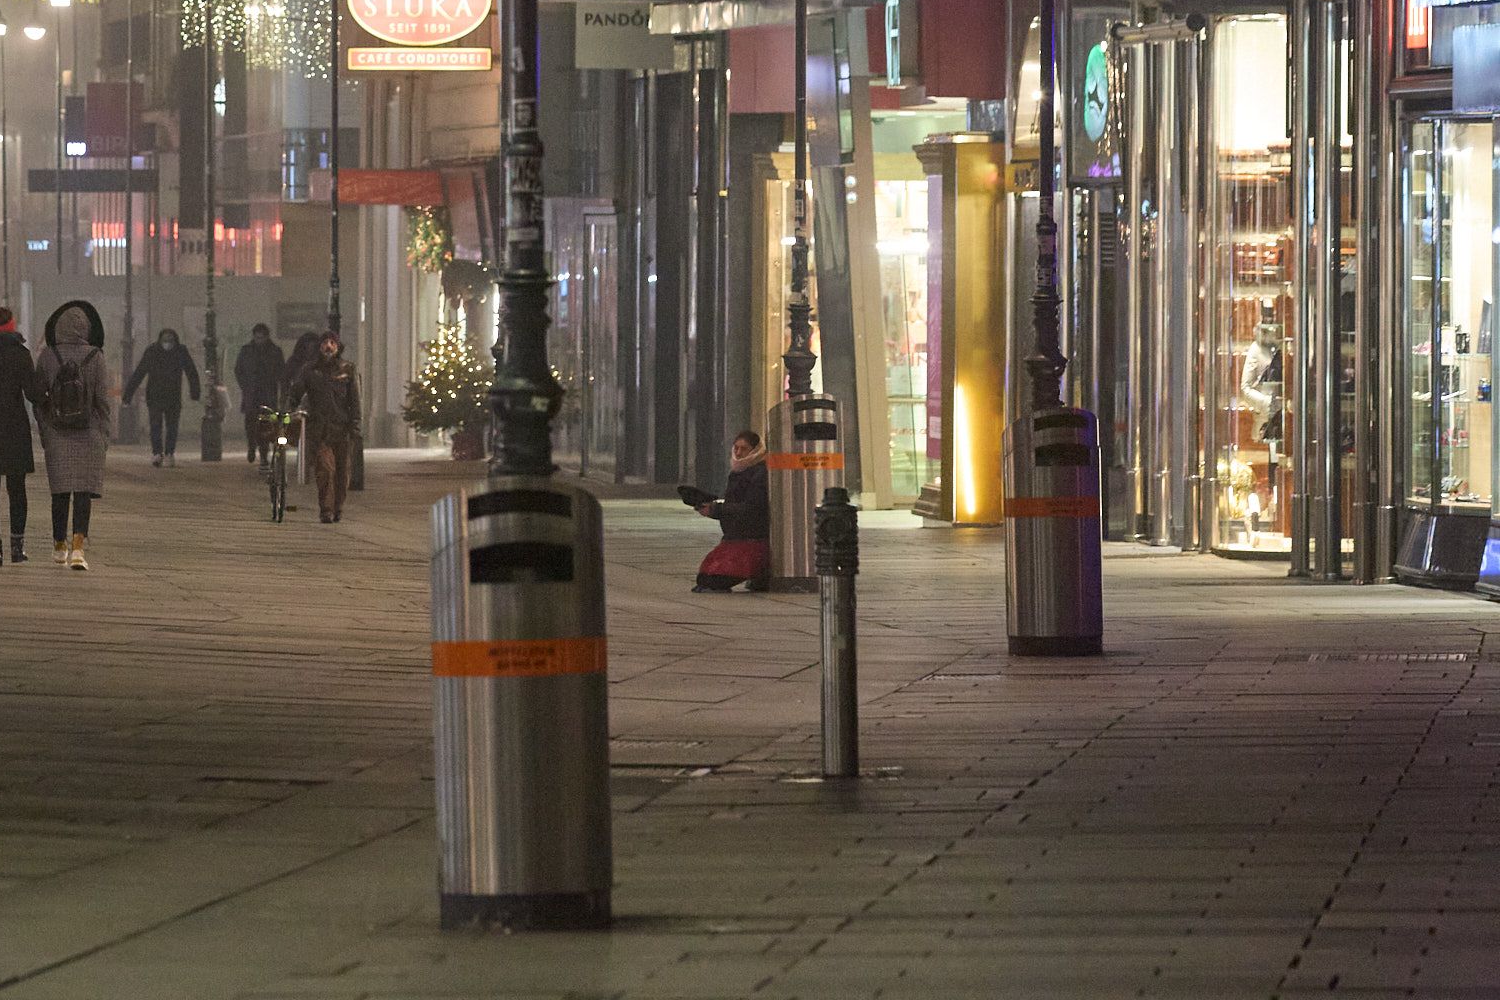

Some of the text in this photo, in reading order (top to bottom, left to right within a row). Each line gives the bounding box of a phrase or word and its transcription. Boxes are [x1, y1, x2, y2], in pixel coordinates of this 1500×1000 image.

[388, 22, 452, 34] SEIT 1891
[357, 50, 481, 64] CAFÉ CONDITOREI
